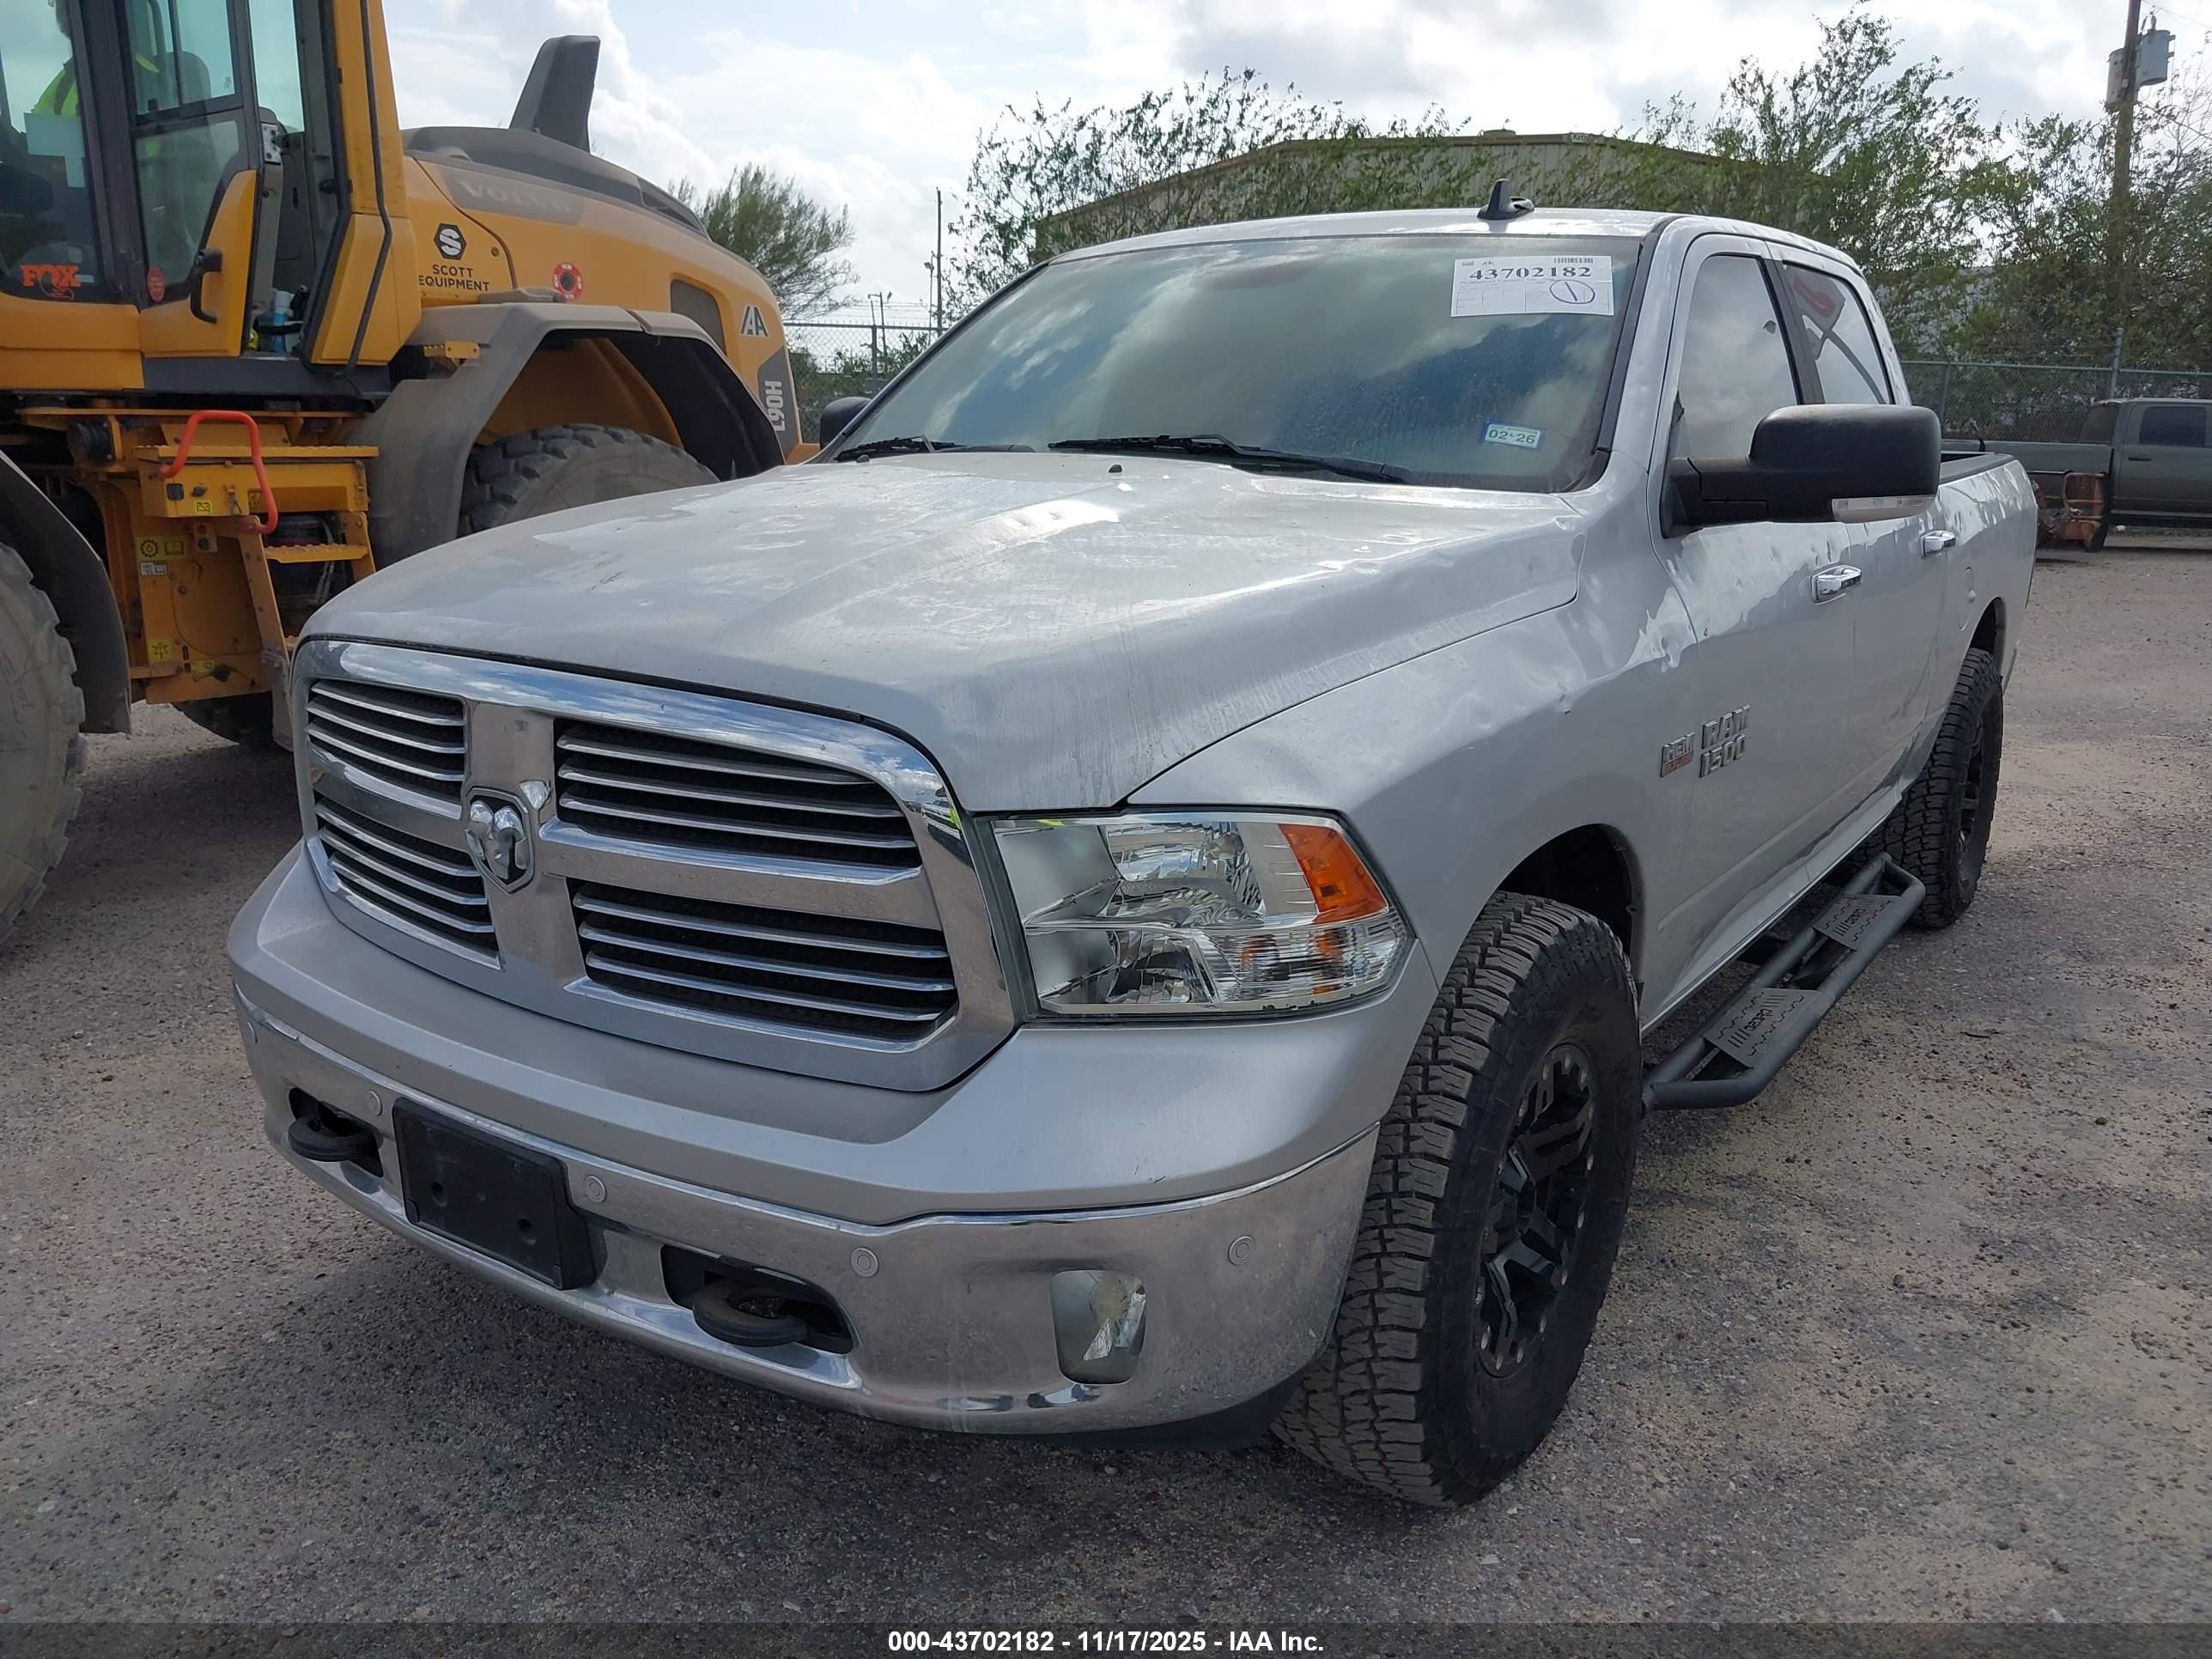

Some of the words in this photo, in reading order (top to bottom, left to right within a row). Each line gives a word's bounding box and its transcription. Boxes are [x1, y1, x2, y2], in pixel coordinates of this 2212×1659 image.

[20, 264, 82, 288] FOX
[432, 264, 474, 278] SCOTT
[1469, 266, 1592, 280] 43702182
[418, 275, 491, 292] EQUIPMENT
[1701, 704, 1752, 750] RAM
[1699, 733, 1747, 777] 1500
